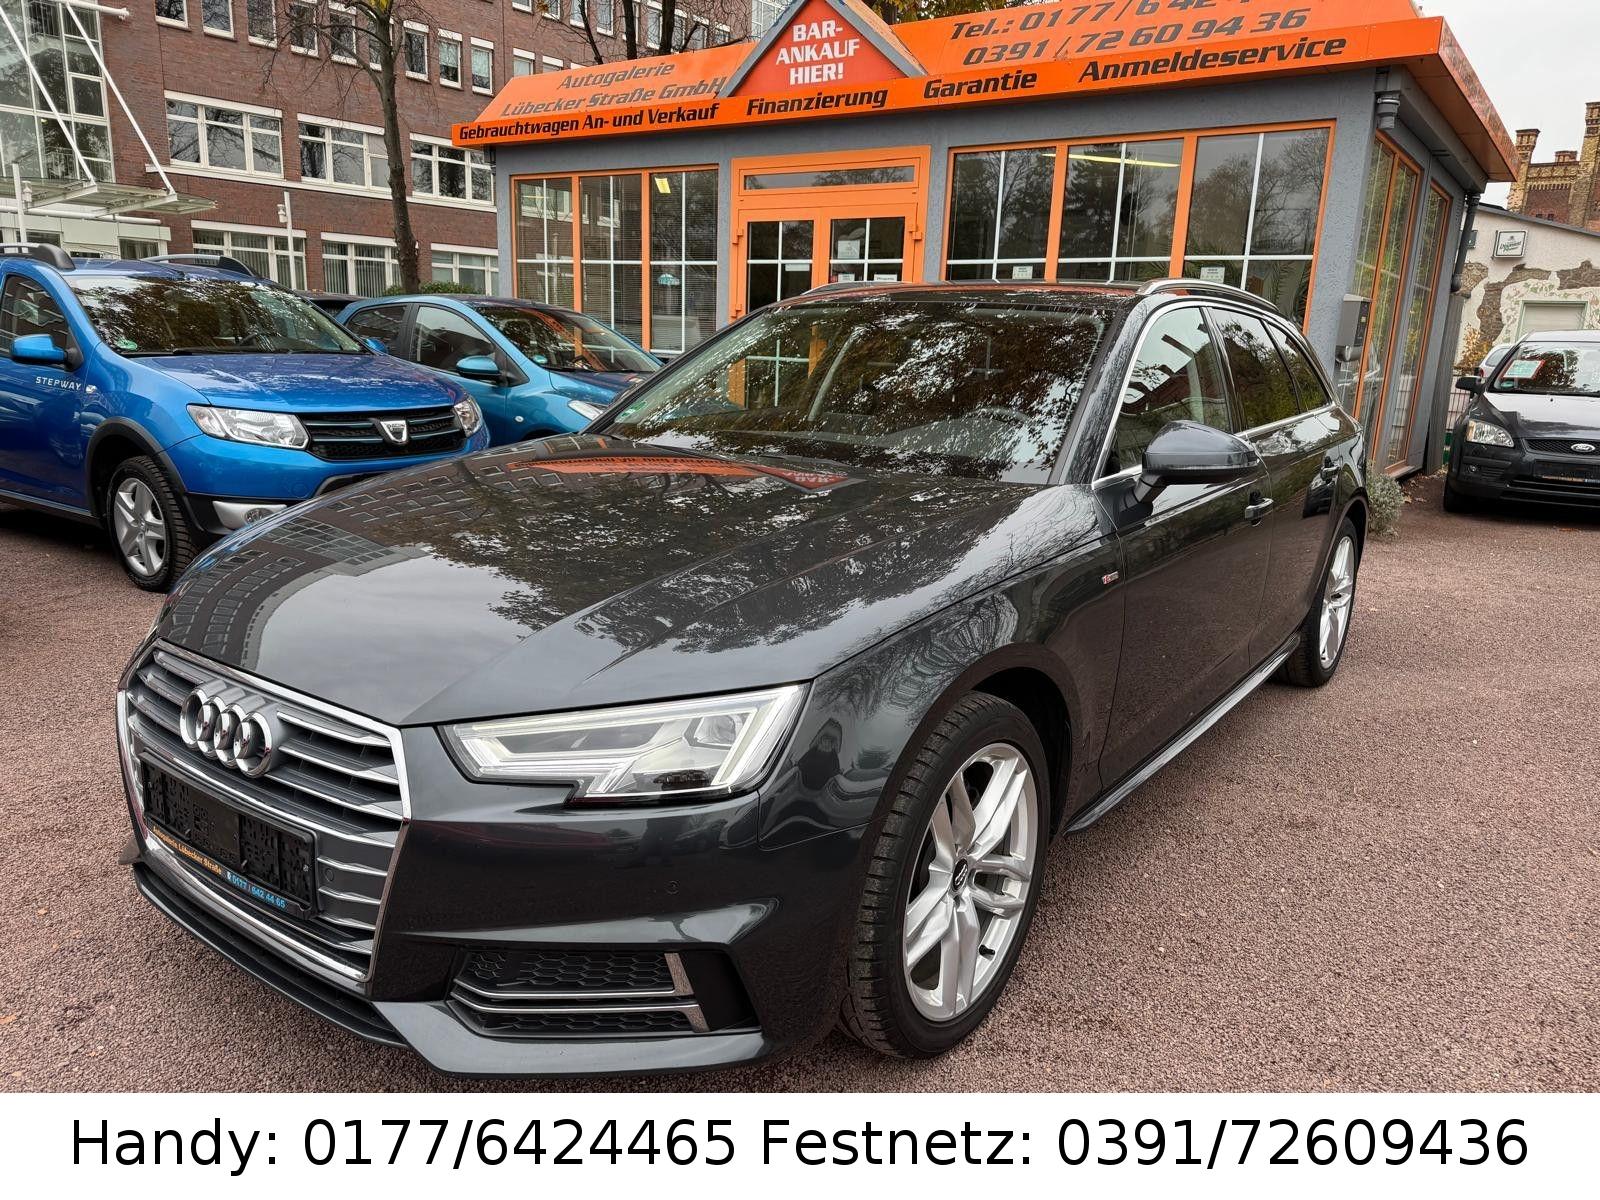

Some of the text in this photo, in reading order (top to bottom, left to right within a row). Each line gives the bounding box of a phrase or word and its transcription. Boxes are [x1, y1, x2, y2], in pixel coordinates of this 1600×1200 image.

[793, 20, 843, 42] BAR-
[951, 18, 1014, 39] Tel.:
[963, 39, 1049, 66] 0391
[1076, 30, 1124, 53] 72
[1129, 23, 1183, 46] 60
[1187, 16, 1245, 40] 94
[1250, 8, 1311, 33] 36
[776, 39, 860, 65] ANKAUF
[1078, 37, 1347, 83] Anmeldeservice
[557, 62, 675, 90] Autogalerie
[790, 62, 844, 85] HIER!
[923, 70, 1037, 99] Garantie
[501, 76, 727, 117] Lübecker Straße GmbH
[746, 89, 889, 115] Finanzierung
[460, 103, 720, 140] Gebrauchtwagen An- und Verkauf
[35, 376, 82, 390] STEPWAY
